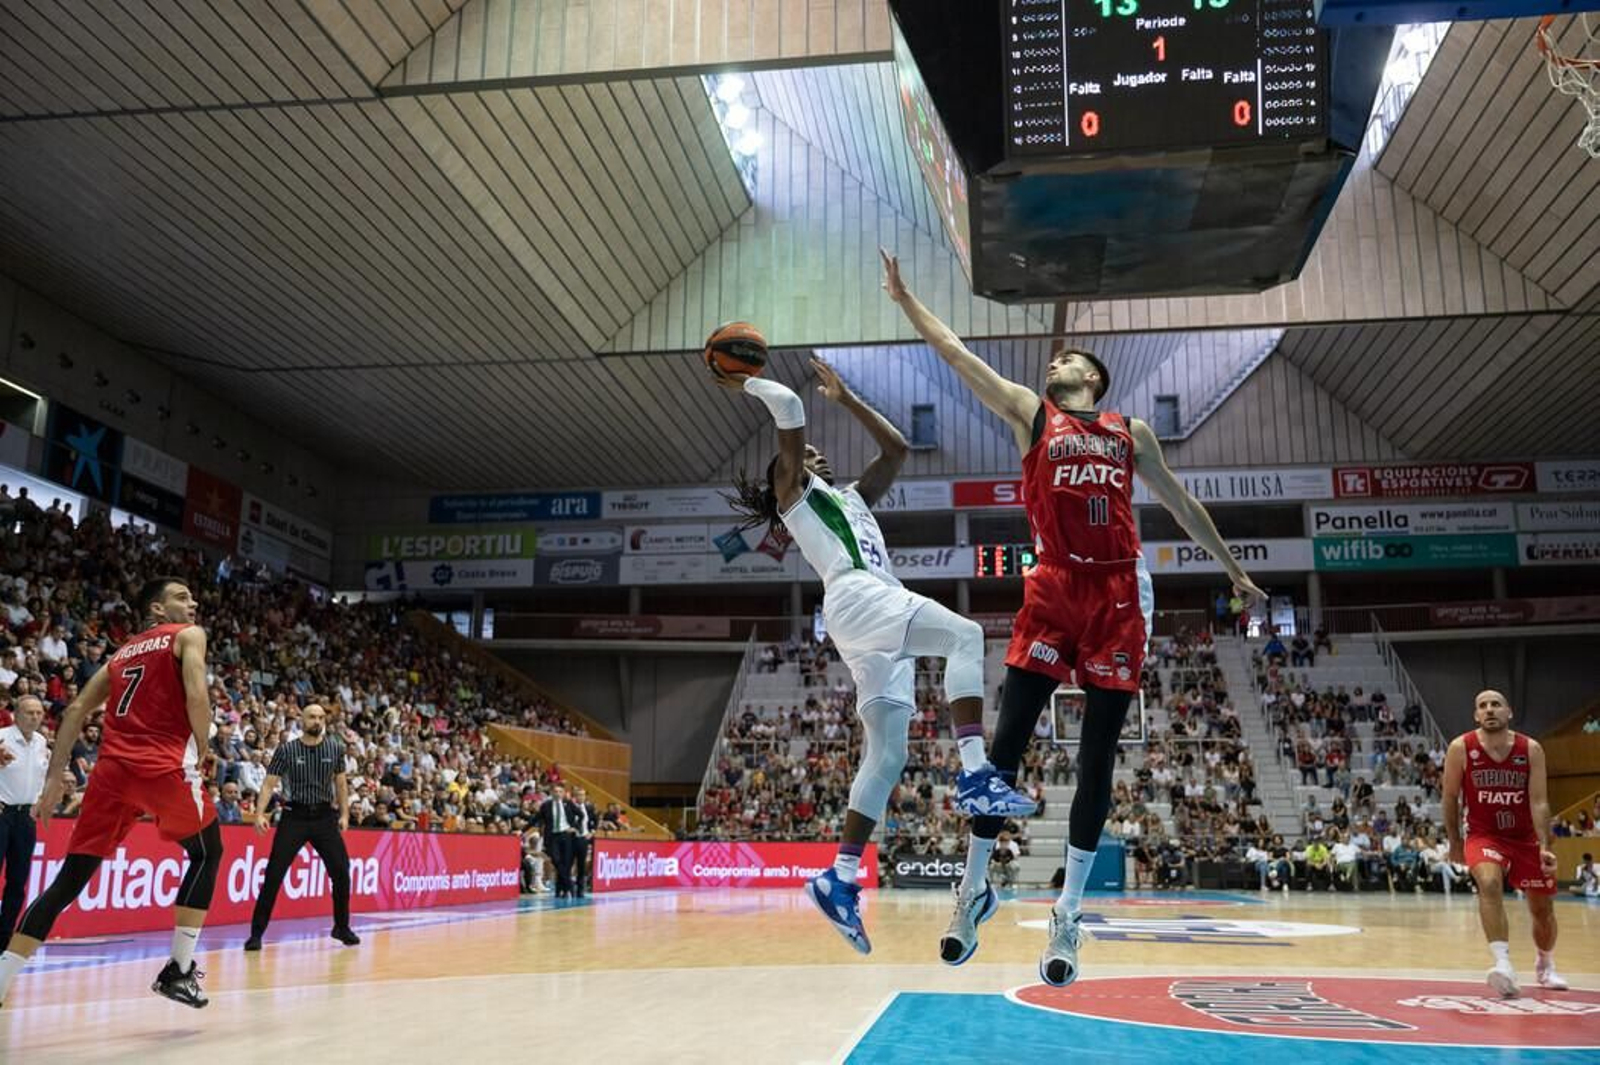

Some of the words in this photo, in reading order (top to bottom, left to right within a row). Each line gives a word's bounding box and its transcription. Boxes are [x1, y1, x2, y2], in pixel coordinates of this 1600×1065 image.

[1135, 16, 1187, 31] Periode
[1152, 35, 1166, 61] 1
[1112, 71, 1168, 88] Jugador
[1181, 67, 1214, 81] Falta
[1223, 70, 1256, 85] Falta
[1080, 111, 1100, 137] 0
[1233, 100, 1252, 126] 0
[1053, 462, 1126, 488] FIATC
[1374, 465, 1479, 481] EQUIPACIONS
[551, 497, 588, 516] ara
[1087, 495, 1110, 525] 11
[1315, 510, 1408, 530] Panella
[381, 534, 522, 557] L'ESPORTIU
[116, 665, 145, 717] 7
[1478, 790, 1525, 805] FIATC
[763, 866, 790, 877] amb
[896, 858, 966, 876] endes
[451, 870, 471, 889] amb
